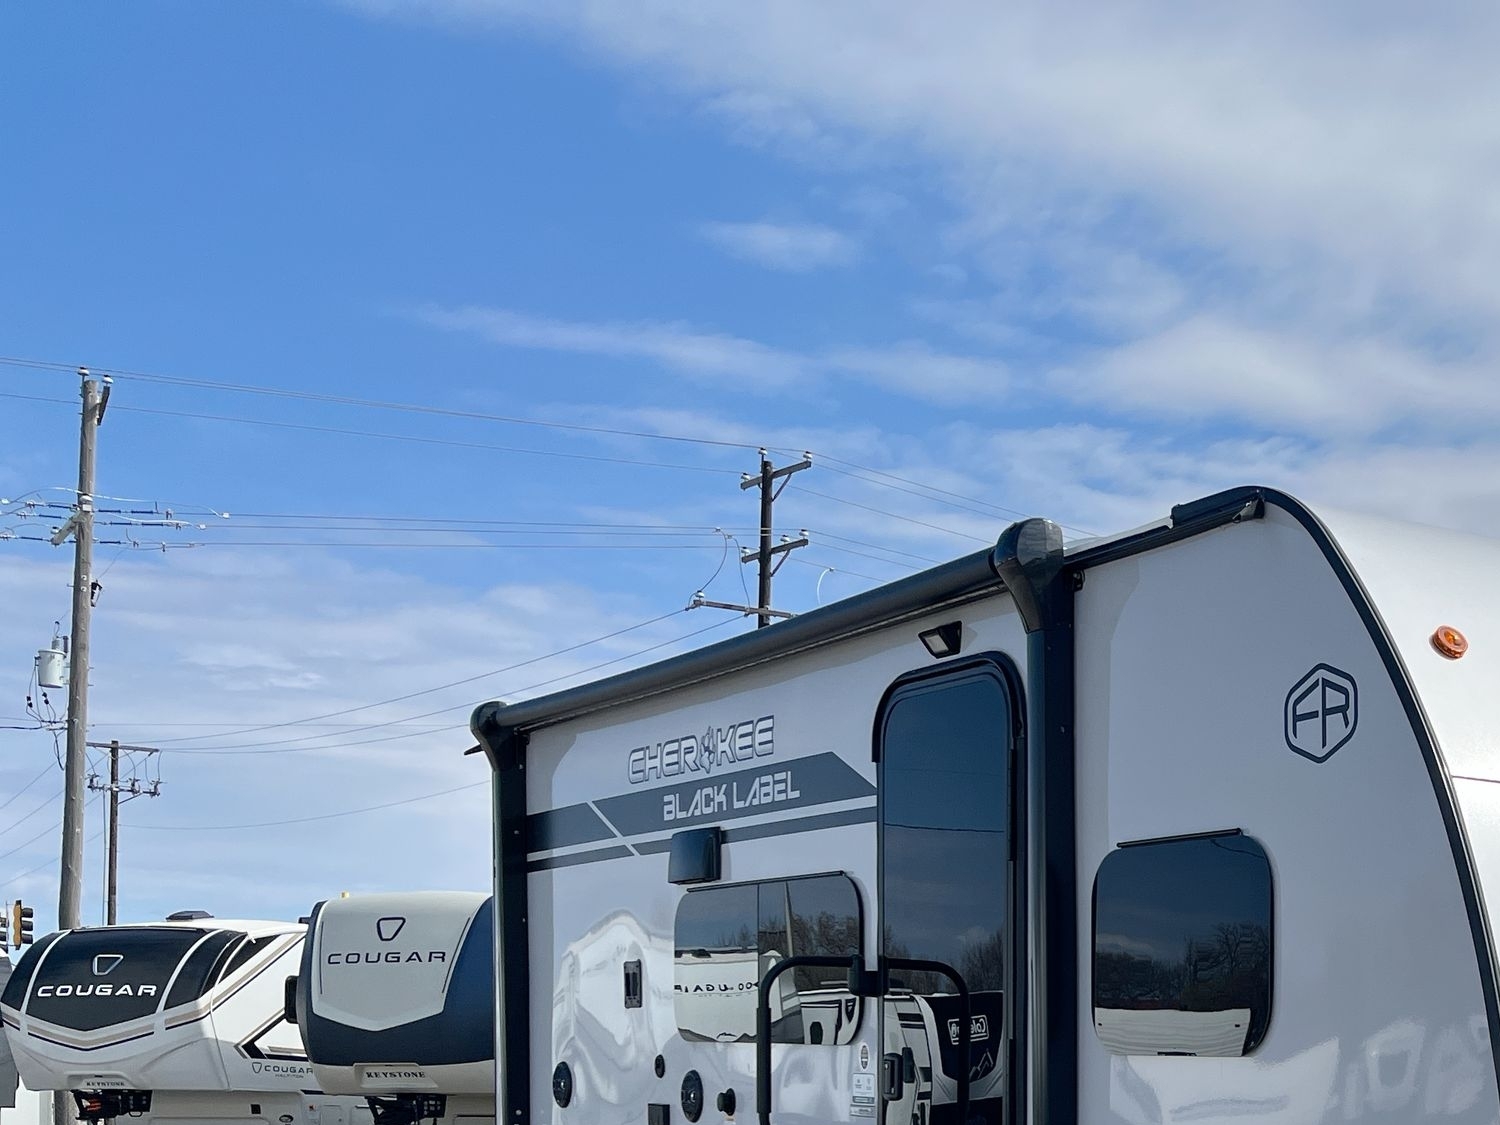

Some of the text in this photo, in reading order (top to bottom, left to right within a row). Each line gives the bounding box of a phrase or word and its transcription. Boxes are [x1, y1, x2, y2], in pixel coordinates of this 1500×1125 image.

[663, 770, 800, 821] BLACK LABEL
[328, 952, 446, 965] COUGAR
[37, 984, 157, 997] COUGAR
[264, 1064, 314, 1074] COUGAR
[366, 1071, 426, 1079] KEYSTONE
